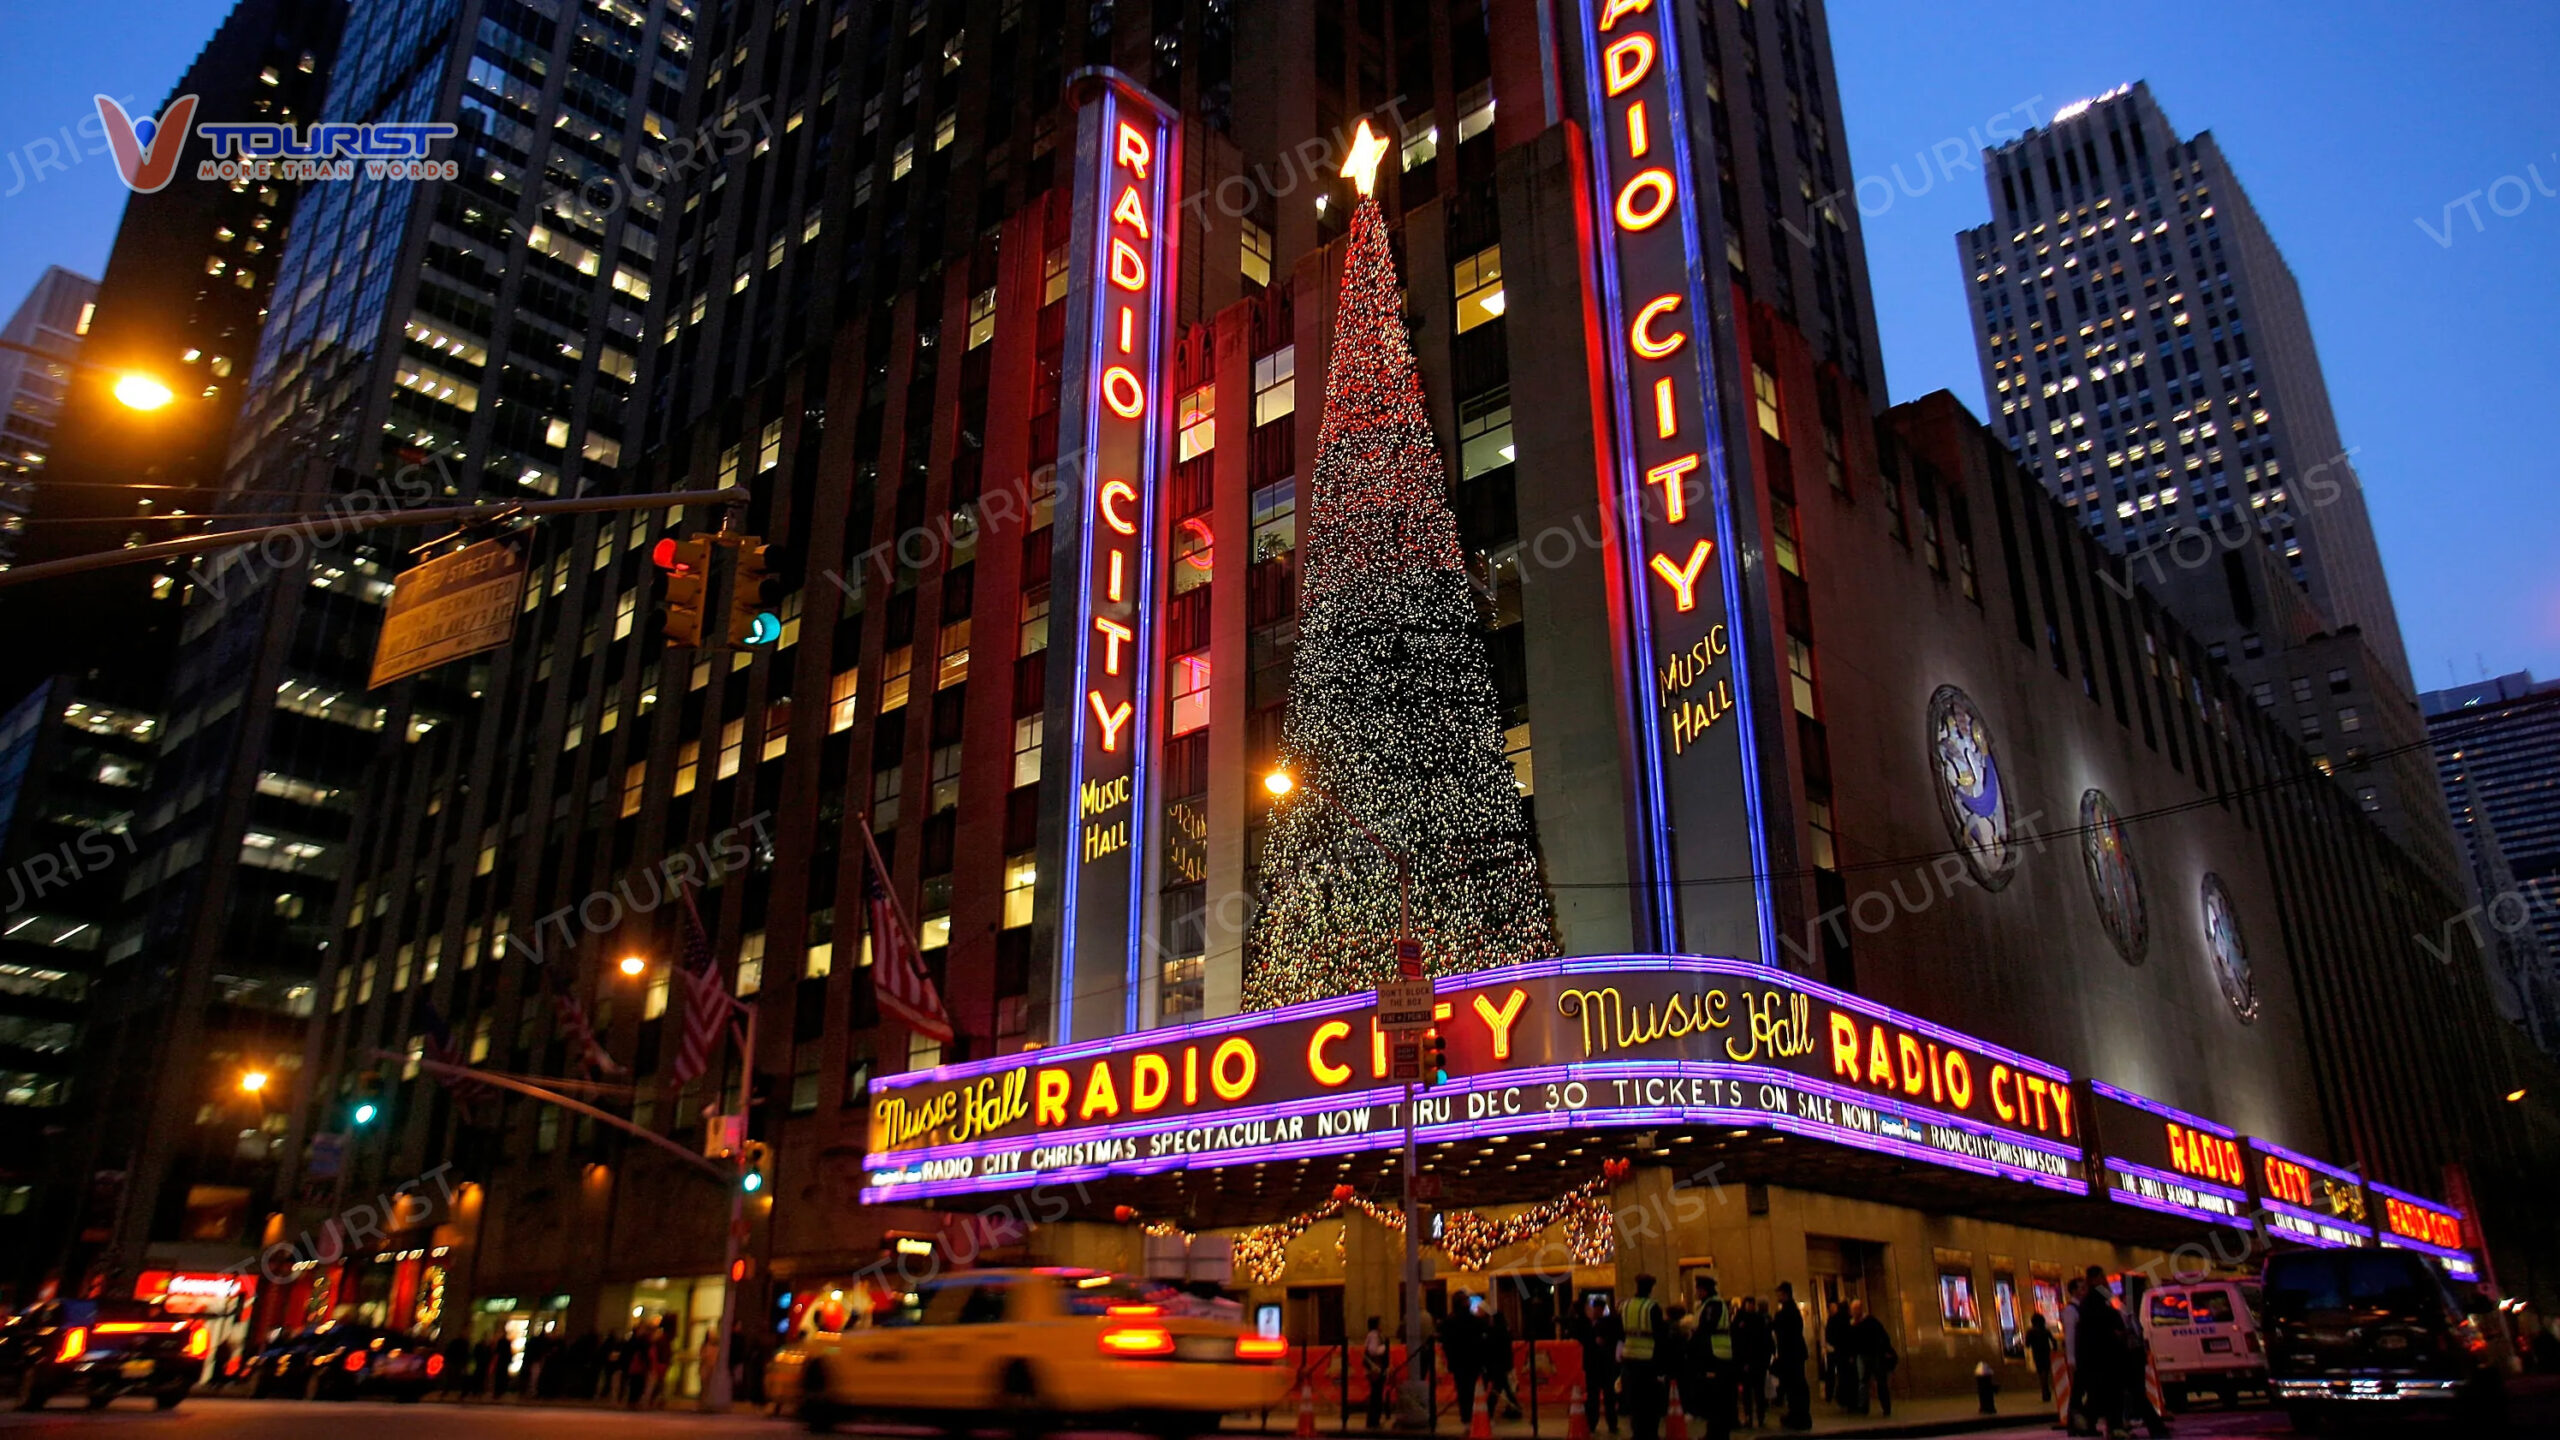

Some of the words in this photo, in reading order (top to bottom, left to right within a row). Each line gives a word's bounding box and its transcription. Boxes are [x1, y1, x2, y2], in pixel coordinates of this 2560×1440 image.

[1102, 120, 1150, 419] RADIO
[1629, 292, 1714, 613] CITY
[1088, 480, 1138, 752] CITY
[1659, 624, 1726, 708] MUSIC
[1672, 679, 1732, 755] HALL
[1080, 775, 1129, 820] MUSIC
[1085, 820, 1128, 864] HALL
[875, 1090, 957, 1149] Music
[949, 1066, 1029, 1143] Hall
[1034, 1037, 1257, 1127] RADIO
[1558, 987, 1729, 1058] Music
[1726, 989, 1815, 1063] Hall
[1830, 1009, 1973, 1110] RADIO
[1990, 1064, 2072, 1138] CITY
[921, 1155, 974, 1182] RADIO
[982, 1150, 1022, 1175] CITY
[1030, 1136, 1138, 1170] CHRISTMAS
[1149, 1116, 1304, 1156] SPECTACULAR
[1317, 1107, 1371, 1137] NOW
[1467, 1087, 1521, 1120] DEC
[1544, 1082, 1588, 1110] 30
[1612, 1078, 1743, 1107] TICKETS
[1760, 1084, 1788, 1114] ON
[1797, 1092, 1835, 1124] SALE
[2165, 1122, 2245, 1186] RADIO
[2264, 1155, 2312, 1207] CITY
[2171, 1325, 2216, 1336] POLICE
